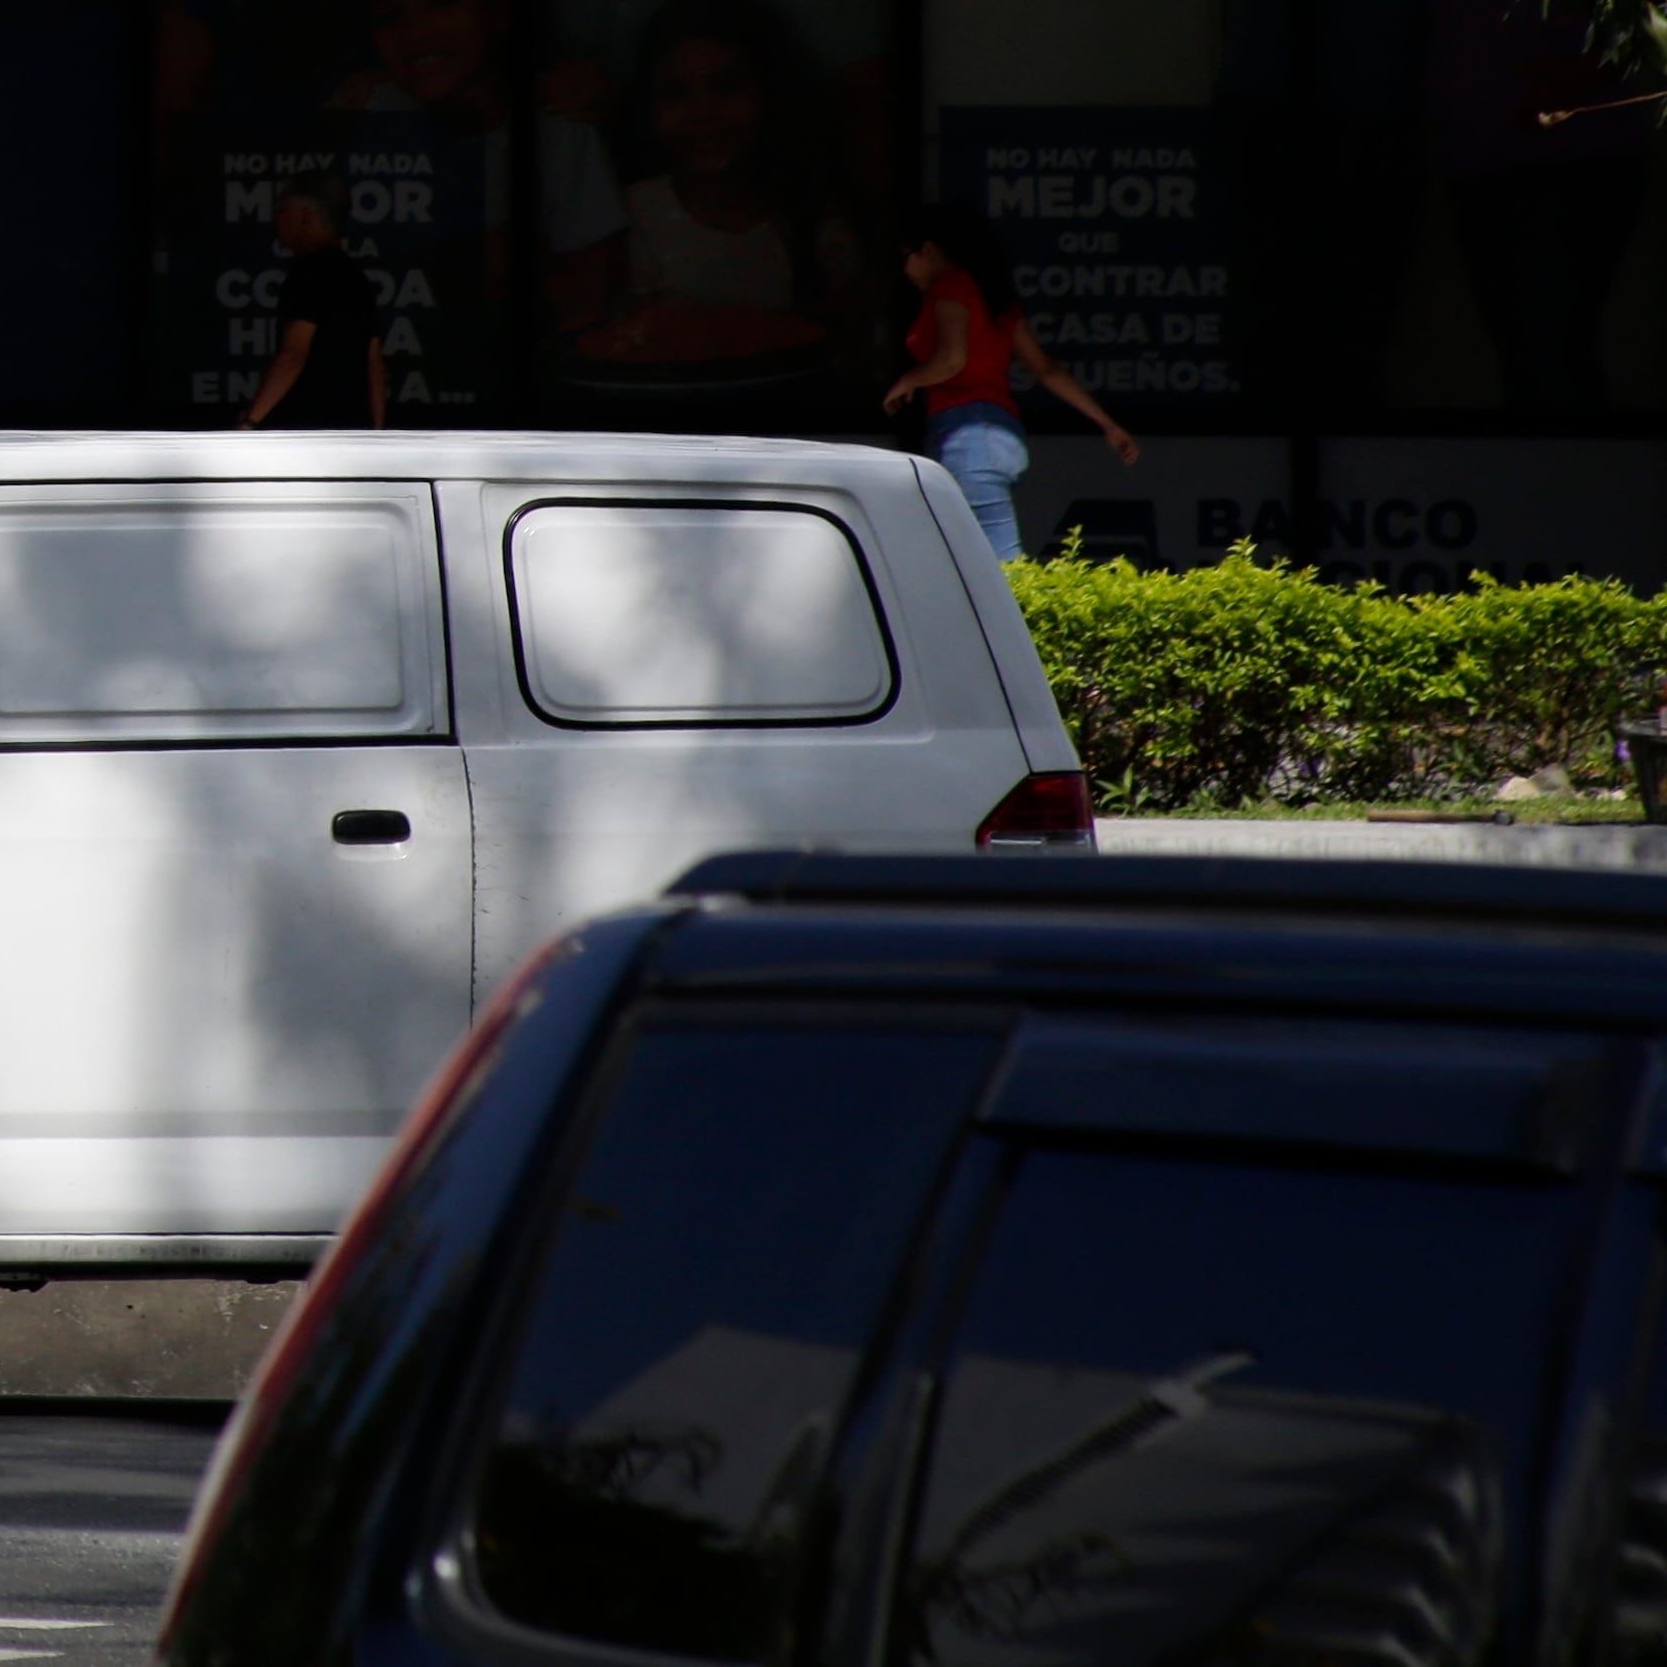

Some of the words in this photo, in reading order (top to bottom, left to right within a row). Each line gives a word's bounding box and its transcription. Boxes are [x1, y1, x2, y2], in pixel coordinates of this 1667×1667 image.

[223, 153, 269, 175] NO
[275, 153, 335, 175] HAY
[349, 153, 434, 175] NADA
[986, 147, 1030, 169] NO
[1037, 147, 1097, 169] HAY
[1112, 147, 1197, 169] NADA
[224, 180, 434, 224] MOR
[987, 174, 1196, 219] MEJOR
[1058, 231, 1121, 253] QUE
[215, 269, 436, 309] CODA
[1012, 265, 1228, 297] CONTRAR
[1030, 312, 1149, 344] CASA
[1162, 313, 1220, 344] DE
[1197, 499, 1477, 549] BANCO
